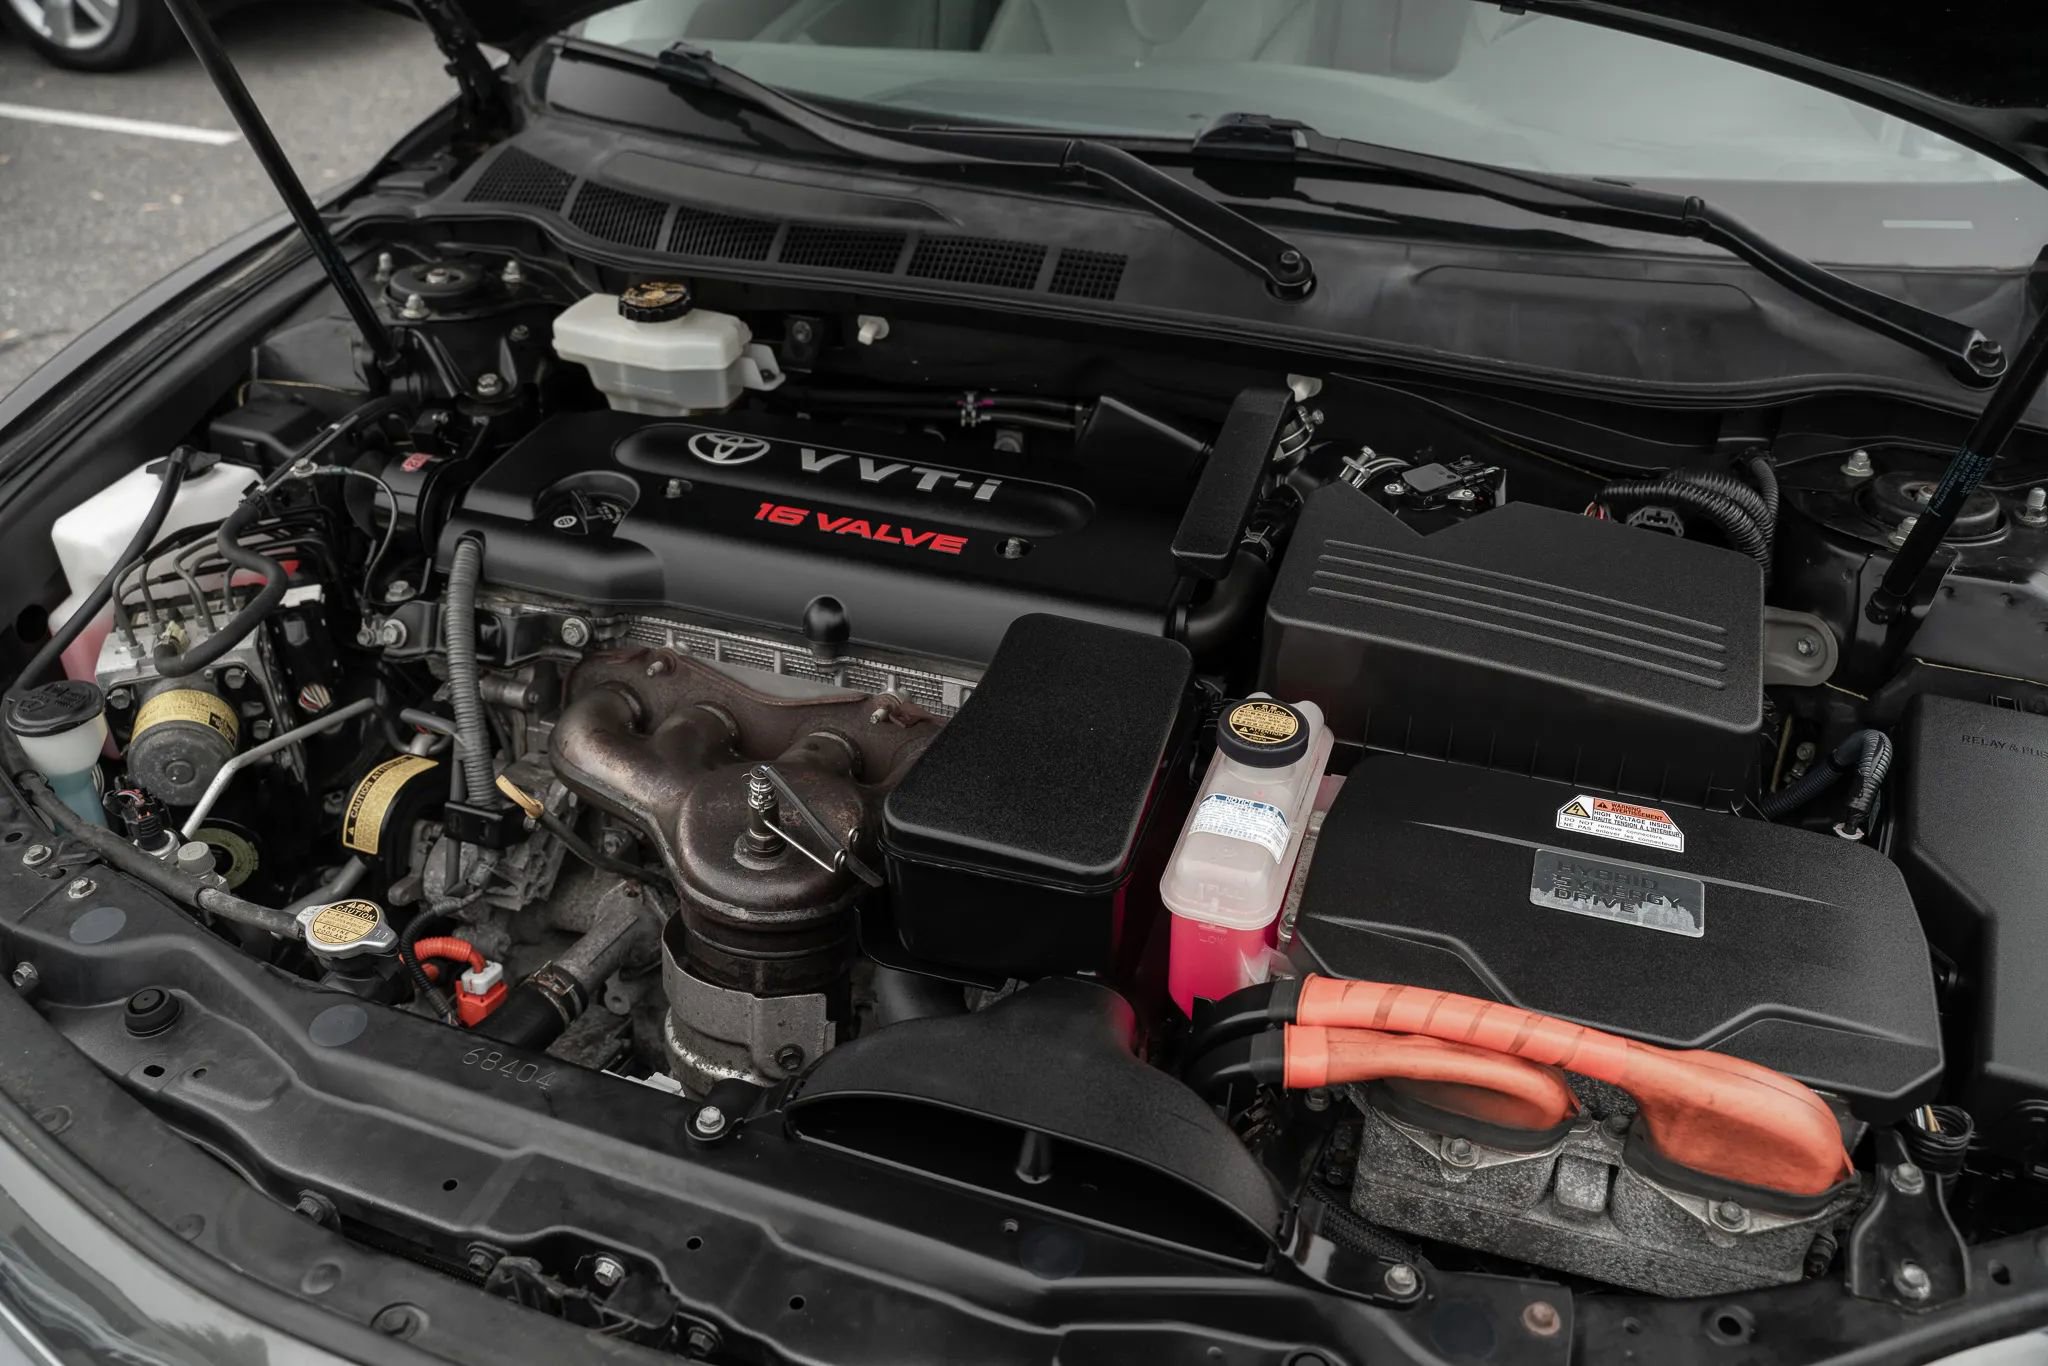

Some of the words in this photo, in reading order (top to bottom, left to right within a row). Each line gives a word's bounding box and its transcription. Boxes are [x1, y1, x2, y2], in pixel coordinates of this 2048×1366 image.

[799, 448, 1003, 502] VVT-i
[754, 502, 811, 526] 16
[815, 512, 970, 555] VALVE
[1961, 734, 2007, 749] RELAY
[2008, 743, 2019, 752] &
[350, 781, 373, 818] CAUTION
[1611, 803, 1642, 812] WARNING
[1593, 816, 1612, 824] HAUTE
[1614, 819, 1638, 829] TENSION
[1594, 810, 1611, 818] HIGH
[1614, 814, 1646, 825] VOLTAGE
[1649, 821, 1673, 830] INSIDE
[1611, 806, 1663, 821] AVERTISSEMENT
[1597, 823, 1623, 832] remove
[1595, 828, 1621, 837] enlever
[1637, 837, 1679, 848] connecteurs
[1554, 889, 1637, 913] DRIVE
[336, 905, 376, 921] CAUTION
[315, 928, 349, 940] COOLANT
[322, 924, 349, 936] ENGINE
[462, 1047, 556, 1090] 68404
